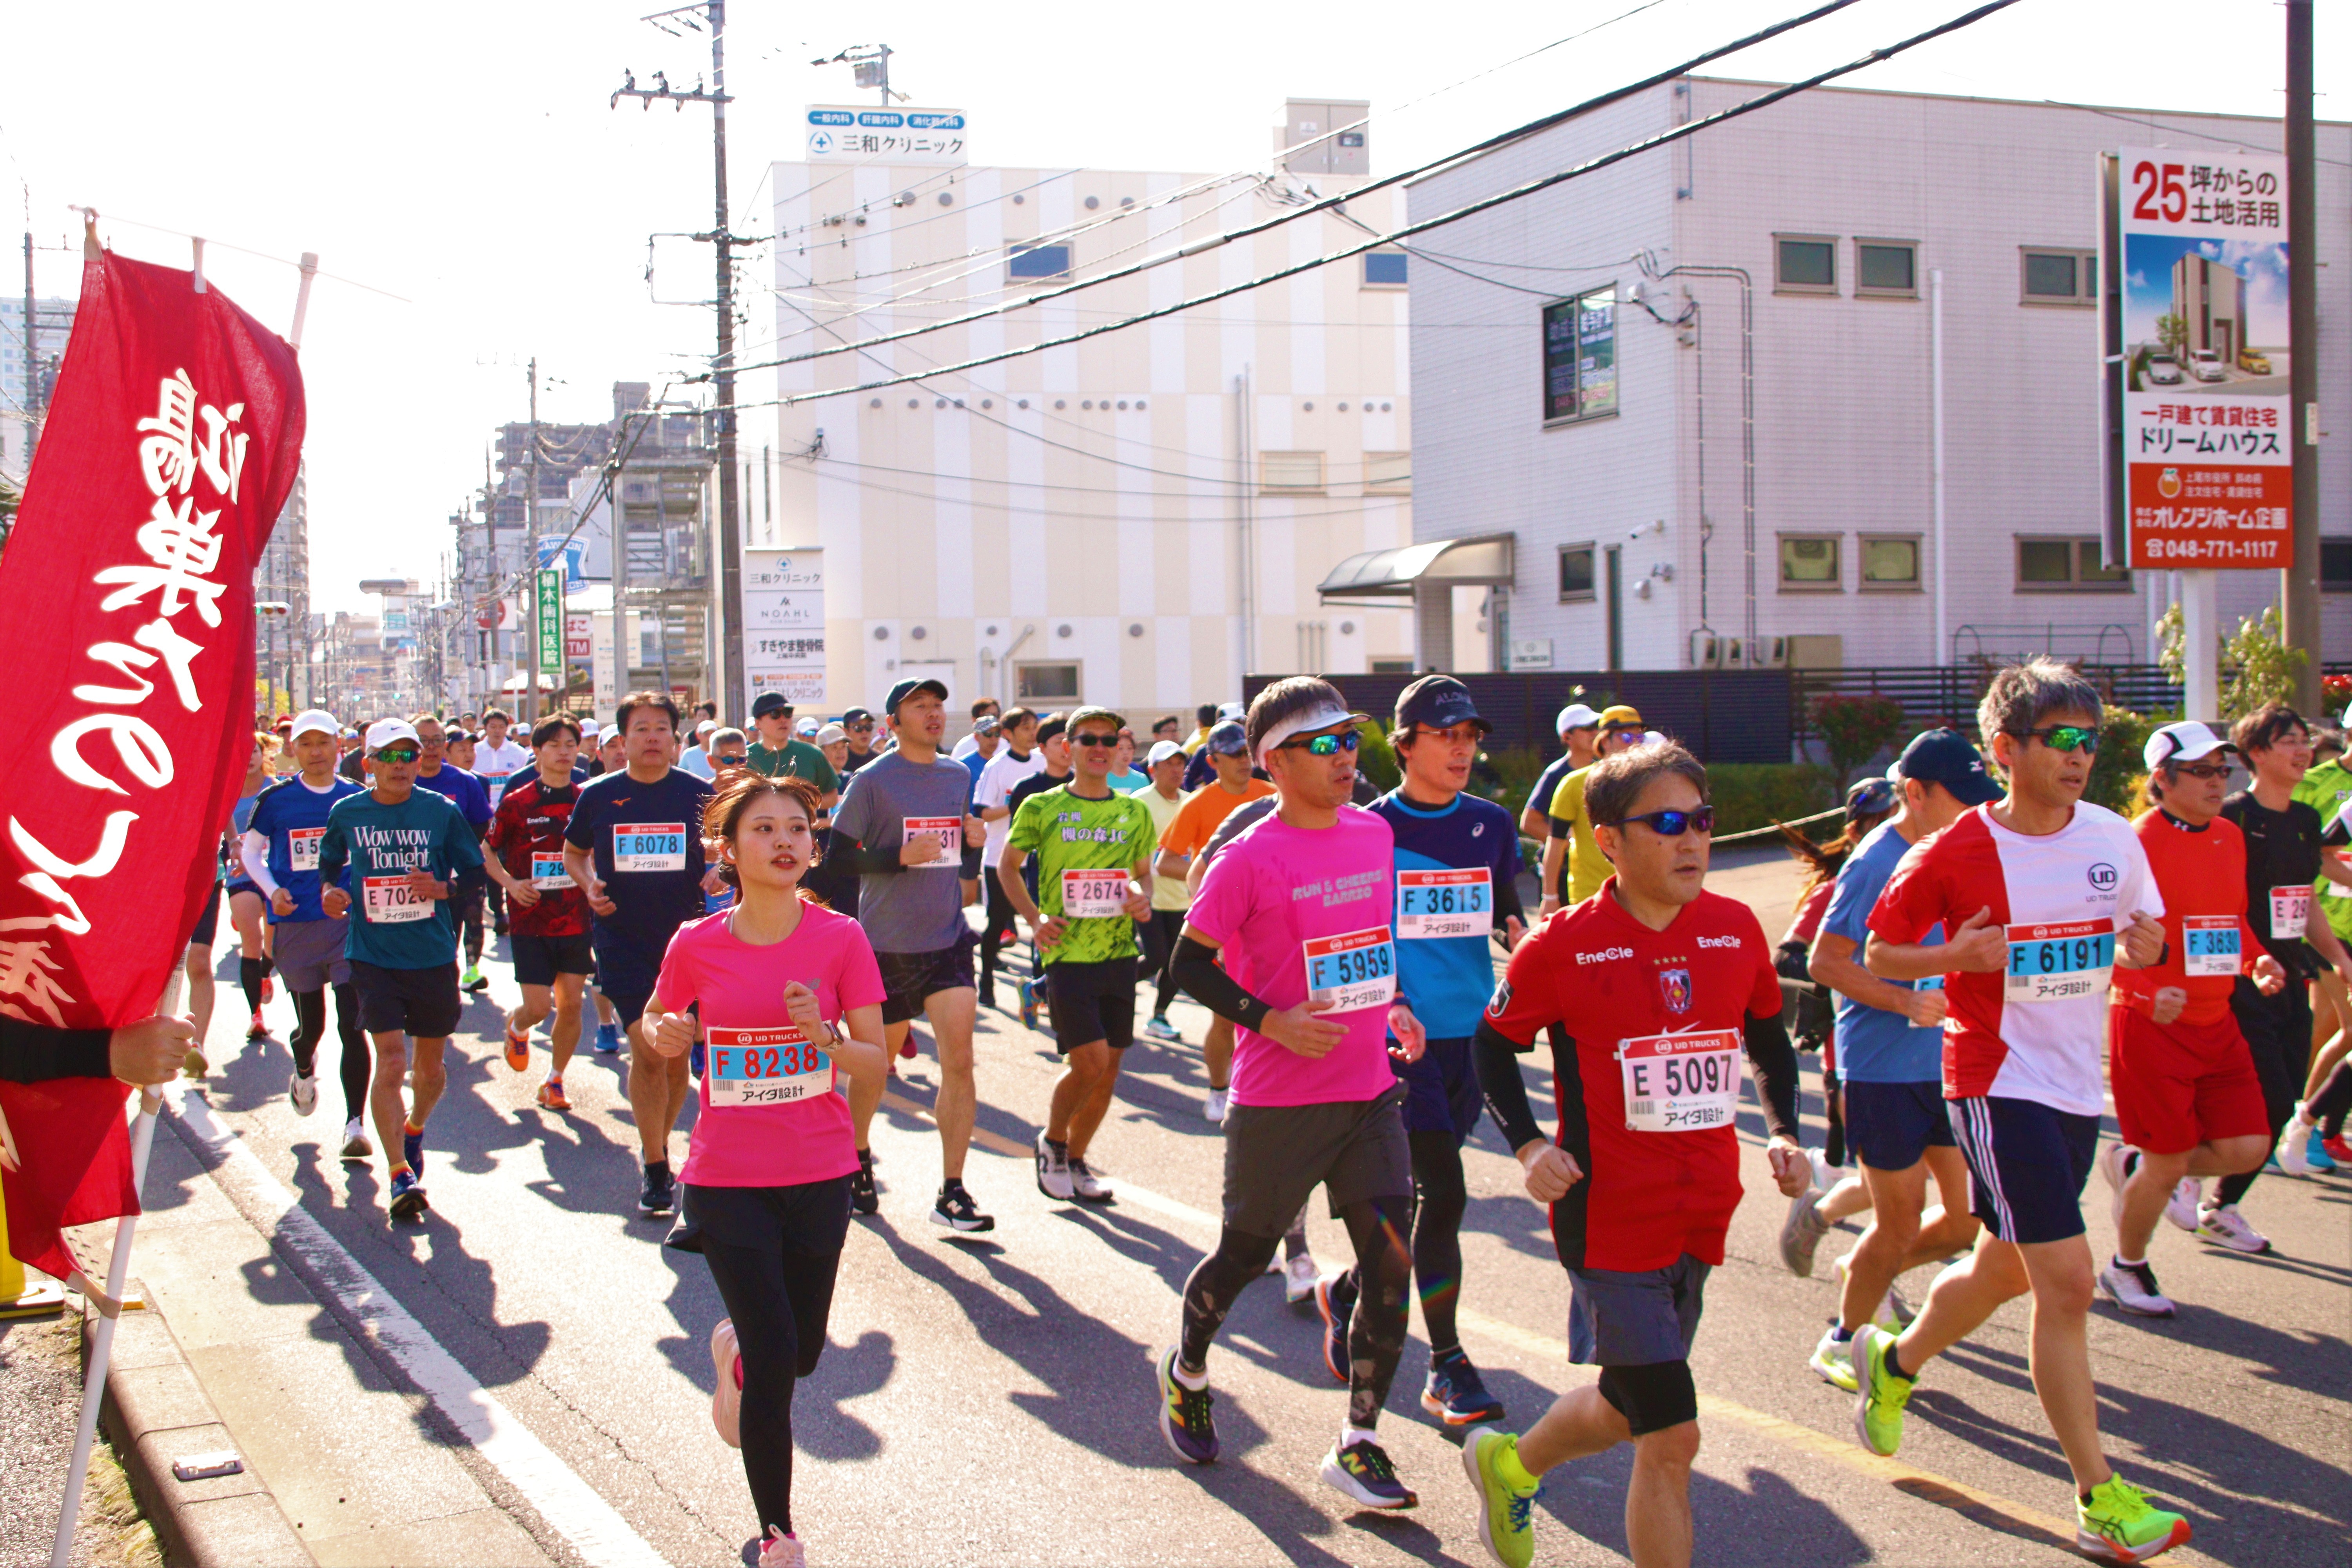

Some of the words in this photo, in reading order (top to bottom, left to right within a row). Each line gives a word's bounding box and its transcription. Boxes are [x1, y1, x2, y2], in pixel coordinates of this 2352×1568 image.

[842, 134, 964, 154] 三和クリニック
[2190, 165, 2277, 196] 坪からの
[2132, 161, 2187, 223] 25
[2190, 197, 2280, 228] 土地活用
[2141, 404, 2277, 427] 一戸建て賃貸住宅
[2140, 427, 2280, 455] ドリームハウス
[2153, 506, 2288, 529] オレンジホーム企画
[2166, 539, 2279, 558] 048-771-1117
[750, 573, 821, 584] 三和クリニック
[541, 572, 558, 664] 植木歯科医院
[568, 619, 588, 632] ばこ
[568, 643, 588, 654] TM
[759, 638, 824, 652] すぎやま整骨院
[353, 825, 394, 848] Wow
[395, 829, 432, 846] wow
[619, 837, 626, 853] F
[635, 835, 678, 854] 6078
[926, 829, 954, 848] 31
[295, 840, 303, 854] G
[368, 846, 431, 872] Tonight
[536, 863, 543, 875] F
[369, 890, 377, 906] E
[1067, 883, 1075, 899] E
[1083, 881, 1123, 900] 2674
[1292, 882, 1321, 901] RUN
[1405, 890, 1416, 912] F
[1427, 886, 1481, 913] 3615
[384, 911, 420, 920] アイダ設計
[1081, 906, 1115, 914] アイダ設計
[2275, 900, 2284, 918] E
[1423, 922, 1471, 934] アイダ設計
[2063, 925, 2094, 934] TRUCKS
[1696, 935, 1742, 949] EneCle
[2190, 933, 2198, 953] F
[1575, 946, 1634, 965] EneCle
[2013, 946, 2026, 972] F
[2040, 937, 2101, 973] 6191
[1313, 960, 1325, 986] F
[1338, 946, 1389, 984] 5959
[1339, 988, 1386, 1008] アイダ設計
[2036, 982, 2092, 997] アイダ設計
[769, 1032, 804, 1041] TRUCKS
[1674, 1041, 1688, 1050] UD
[1690, 1038, 1721, 1048] TRUCKS
[716, 1050, 730, 1076] F
[744, 1044, 819, 1079] 8238
[1633, 1064, 1650, 1096] E
[1666, 1054, 1732, 1096] 5097
[742, 1085, 805, 1102] アイダ設計
[1665, 1107, 1724, 1127] アイダ設計
